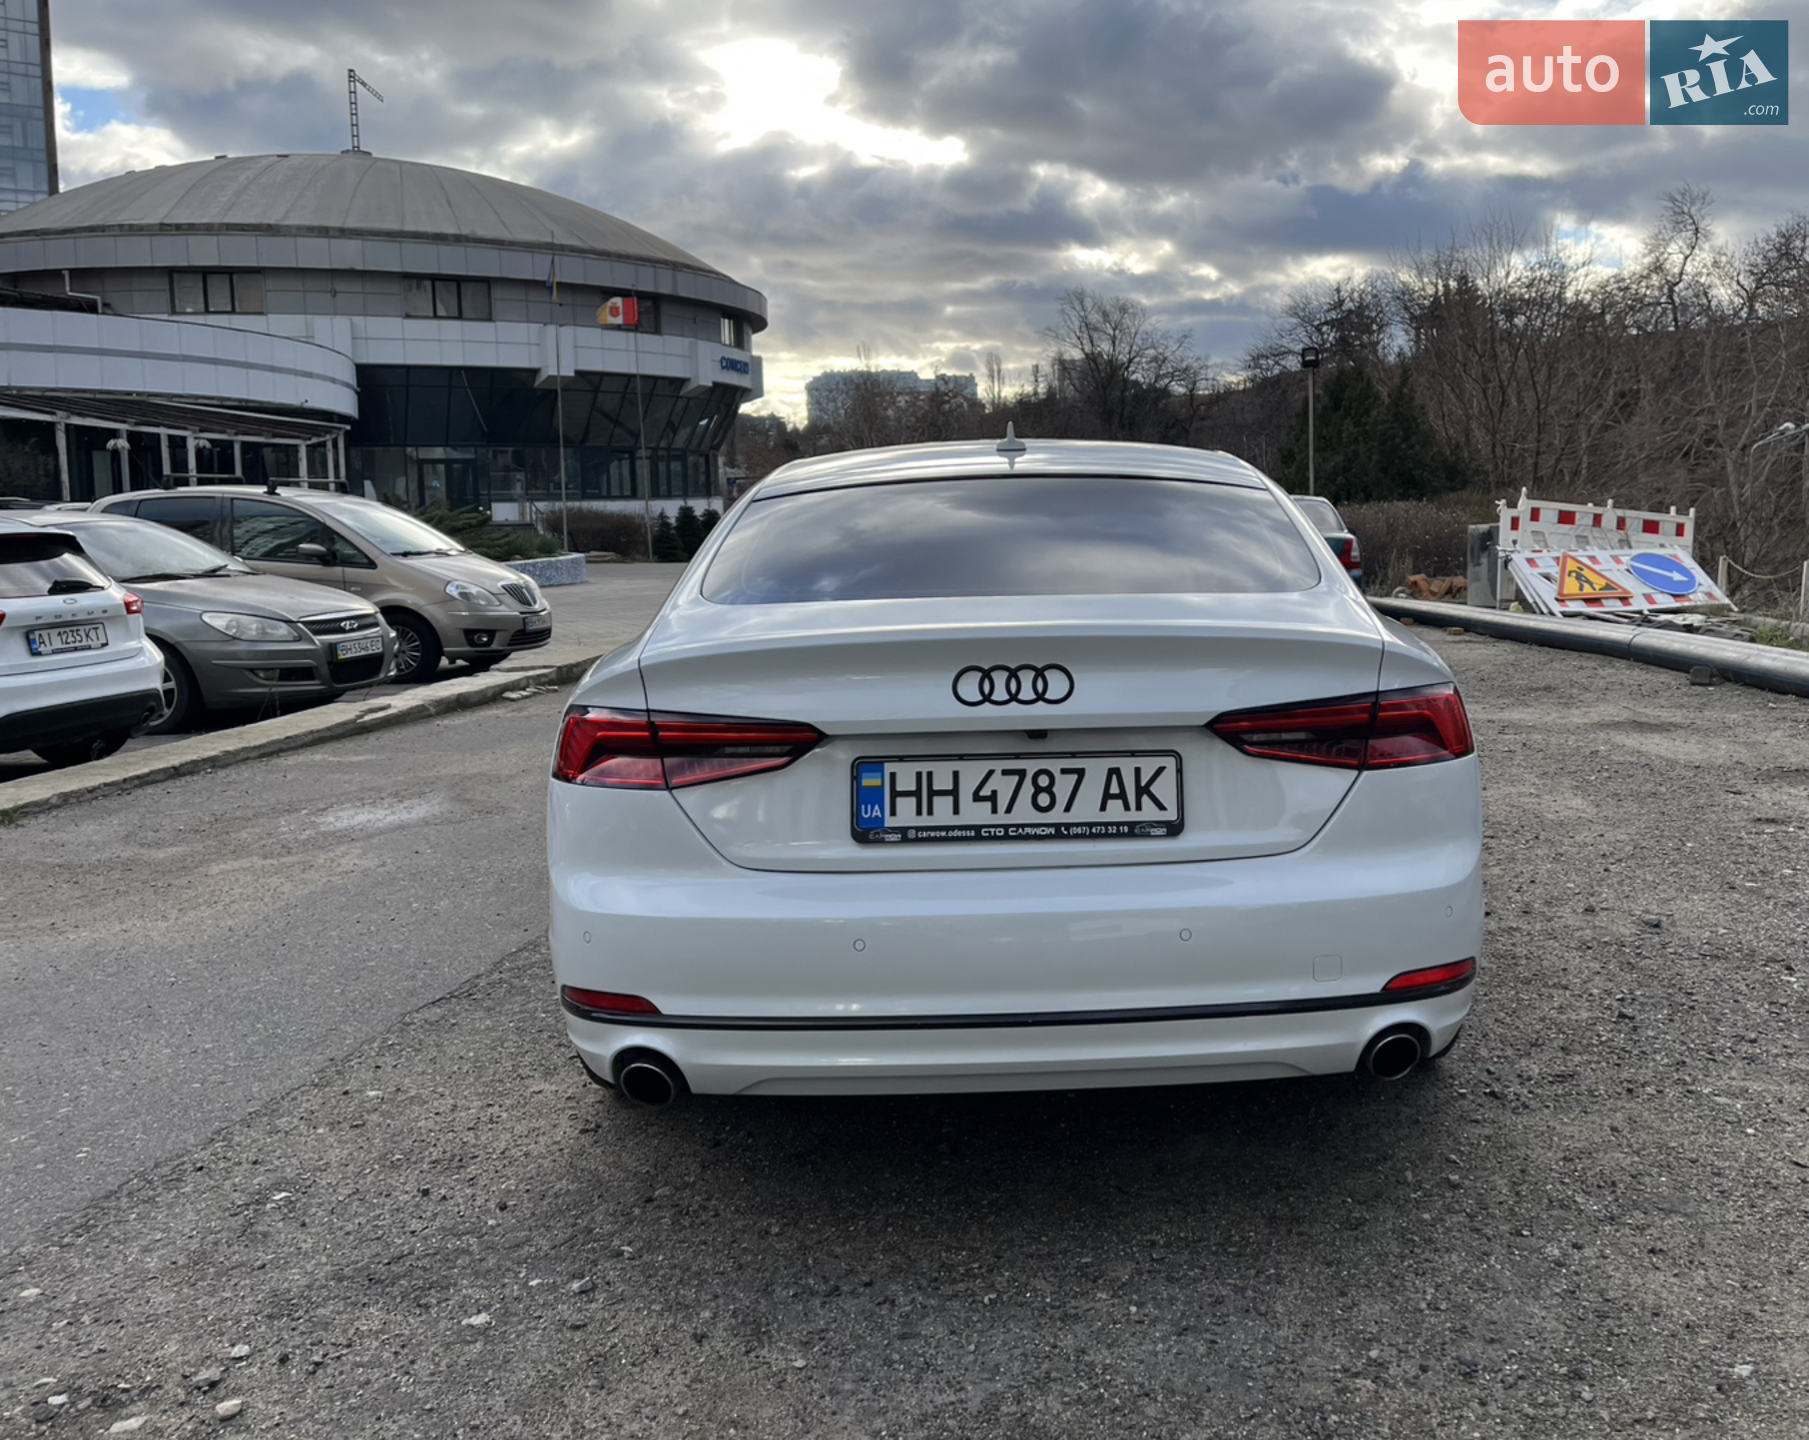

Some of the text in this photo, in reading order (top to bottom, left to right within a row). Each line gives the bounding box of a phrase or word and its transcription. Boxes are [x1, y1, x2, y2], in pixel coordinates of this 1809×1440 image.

[57, 628, 83, 645] 1235
[84, 626, 100, 642] KT
[889, 766, 1169, 817] HH 4787 AK
[861, 803, 882, 819] UA
[917, 828, 976, 839] carwow.odessa
[1091, 825, 1106, 835] 473
[1107, 825, 1117, 834] 32
